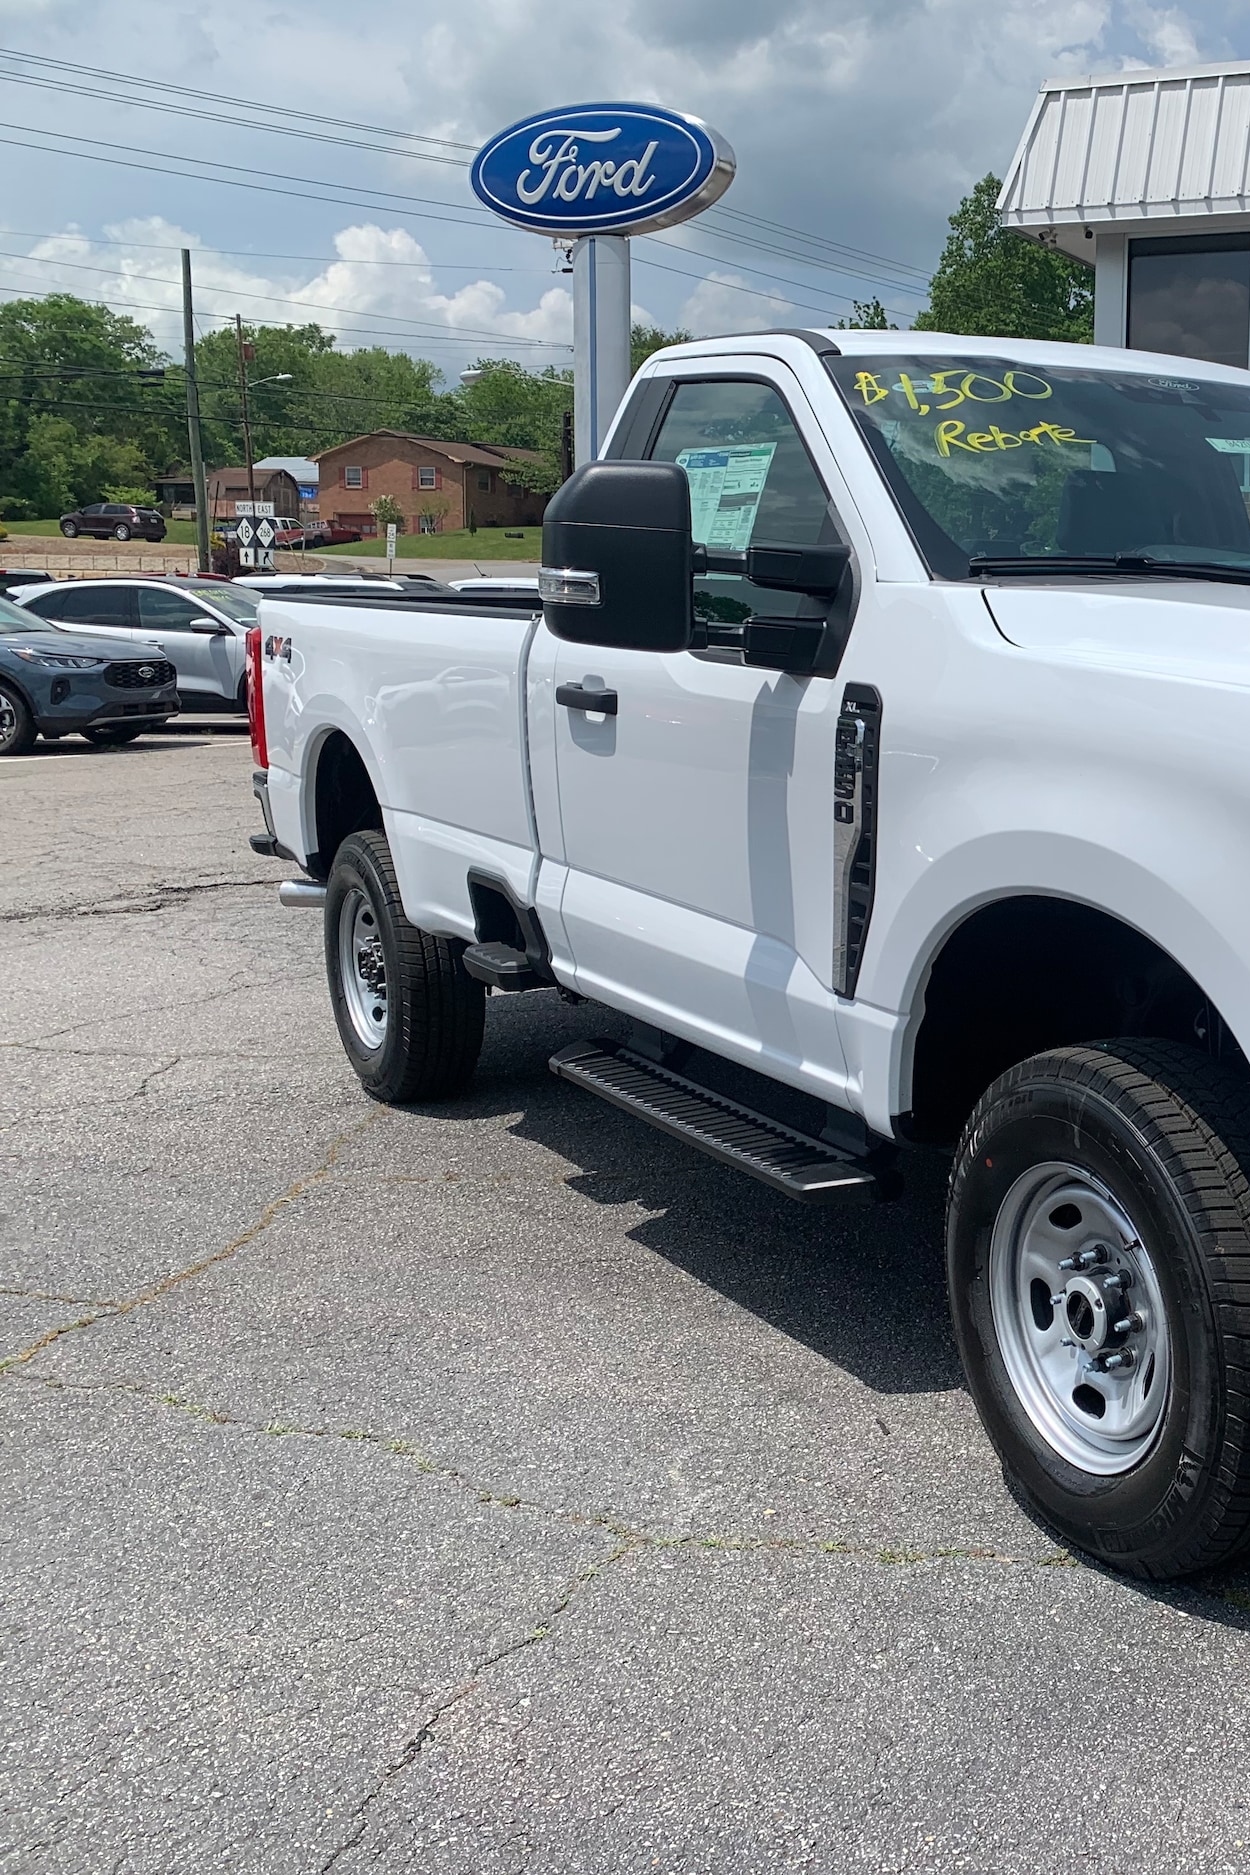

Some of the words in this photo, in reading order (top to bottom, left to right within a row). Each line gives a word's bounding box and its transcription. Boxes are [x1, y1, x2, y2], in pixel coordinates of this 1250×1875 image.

[516, 127, 659, 205] Ford
[1159, 379, 1192, 390] Ford
[854, 370, 1053, 416] $1,500
[934, 420, 1098, 457] Rebate
[236, 504, 252, 512] NORTH
[257, 505, 271, 514] EAST
[240, 525, 250, 539] 18
[260, 527, 271, 538] 268
[845, 701, 860, 713] XL
